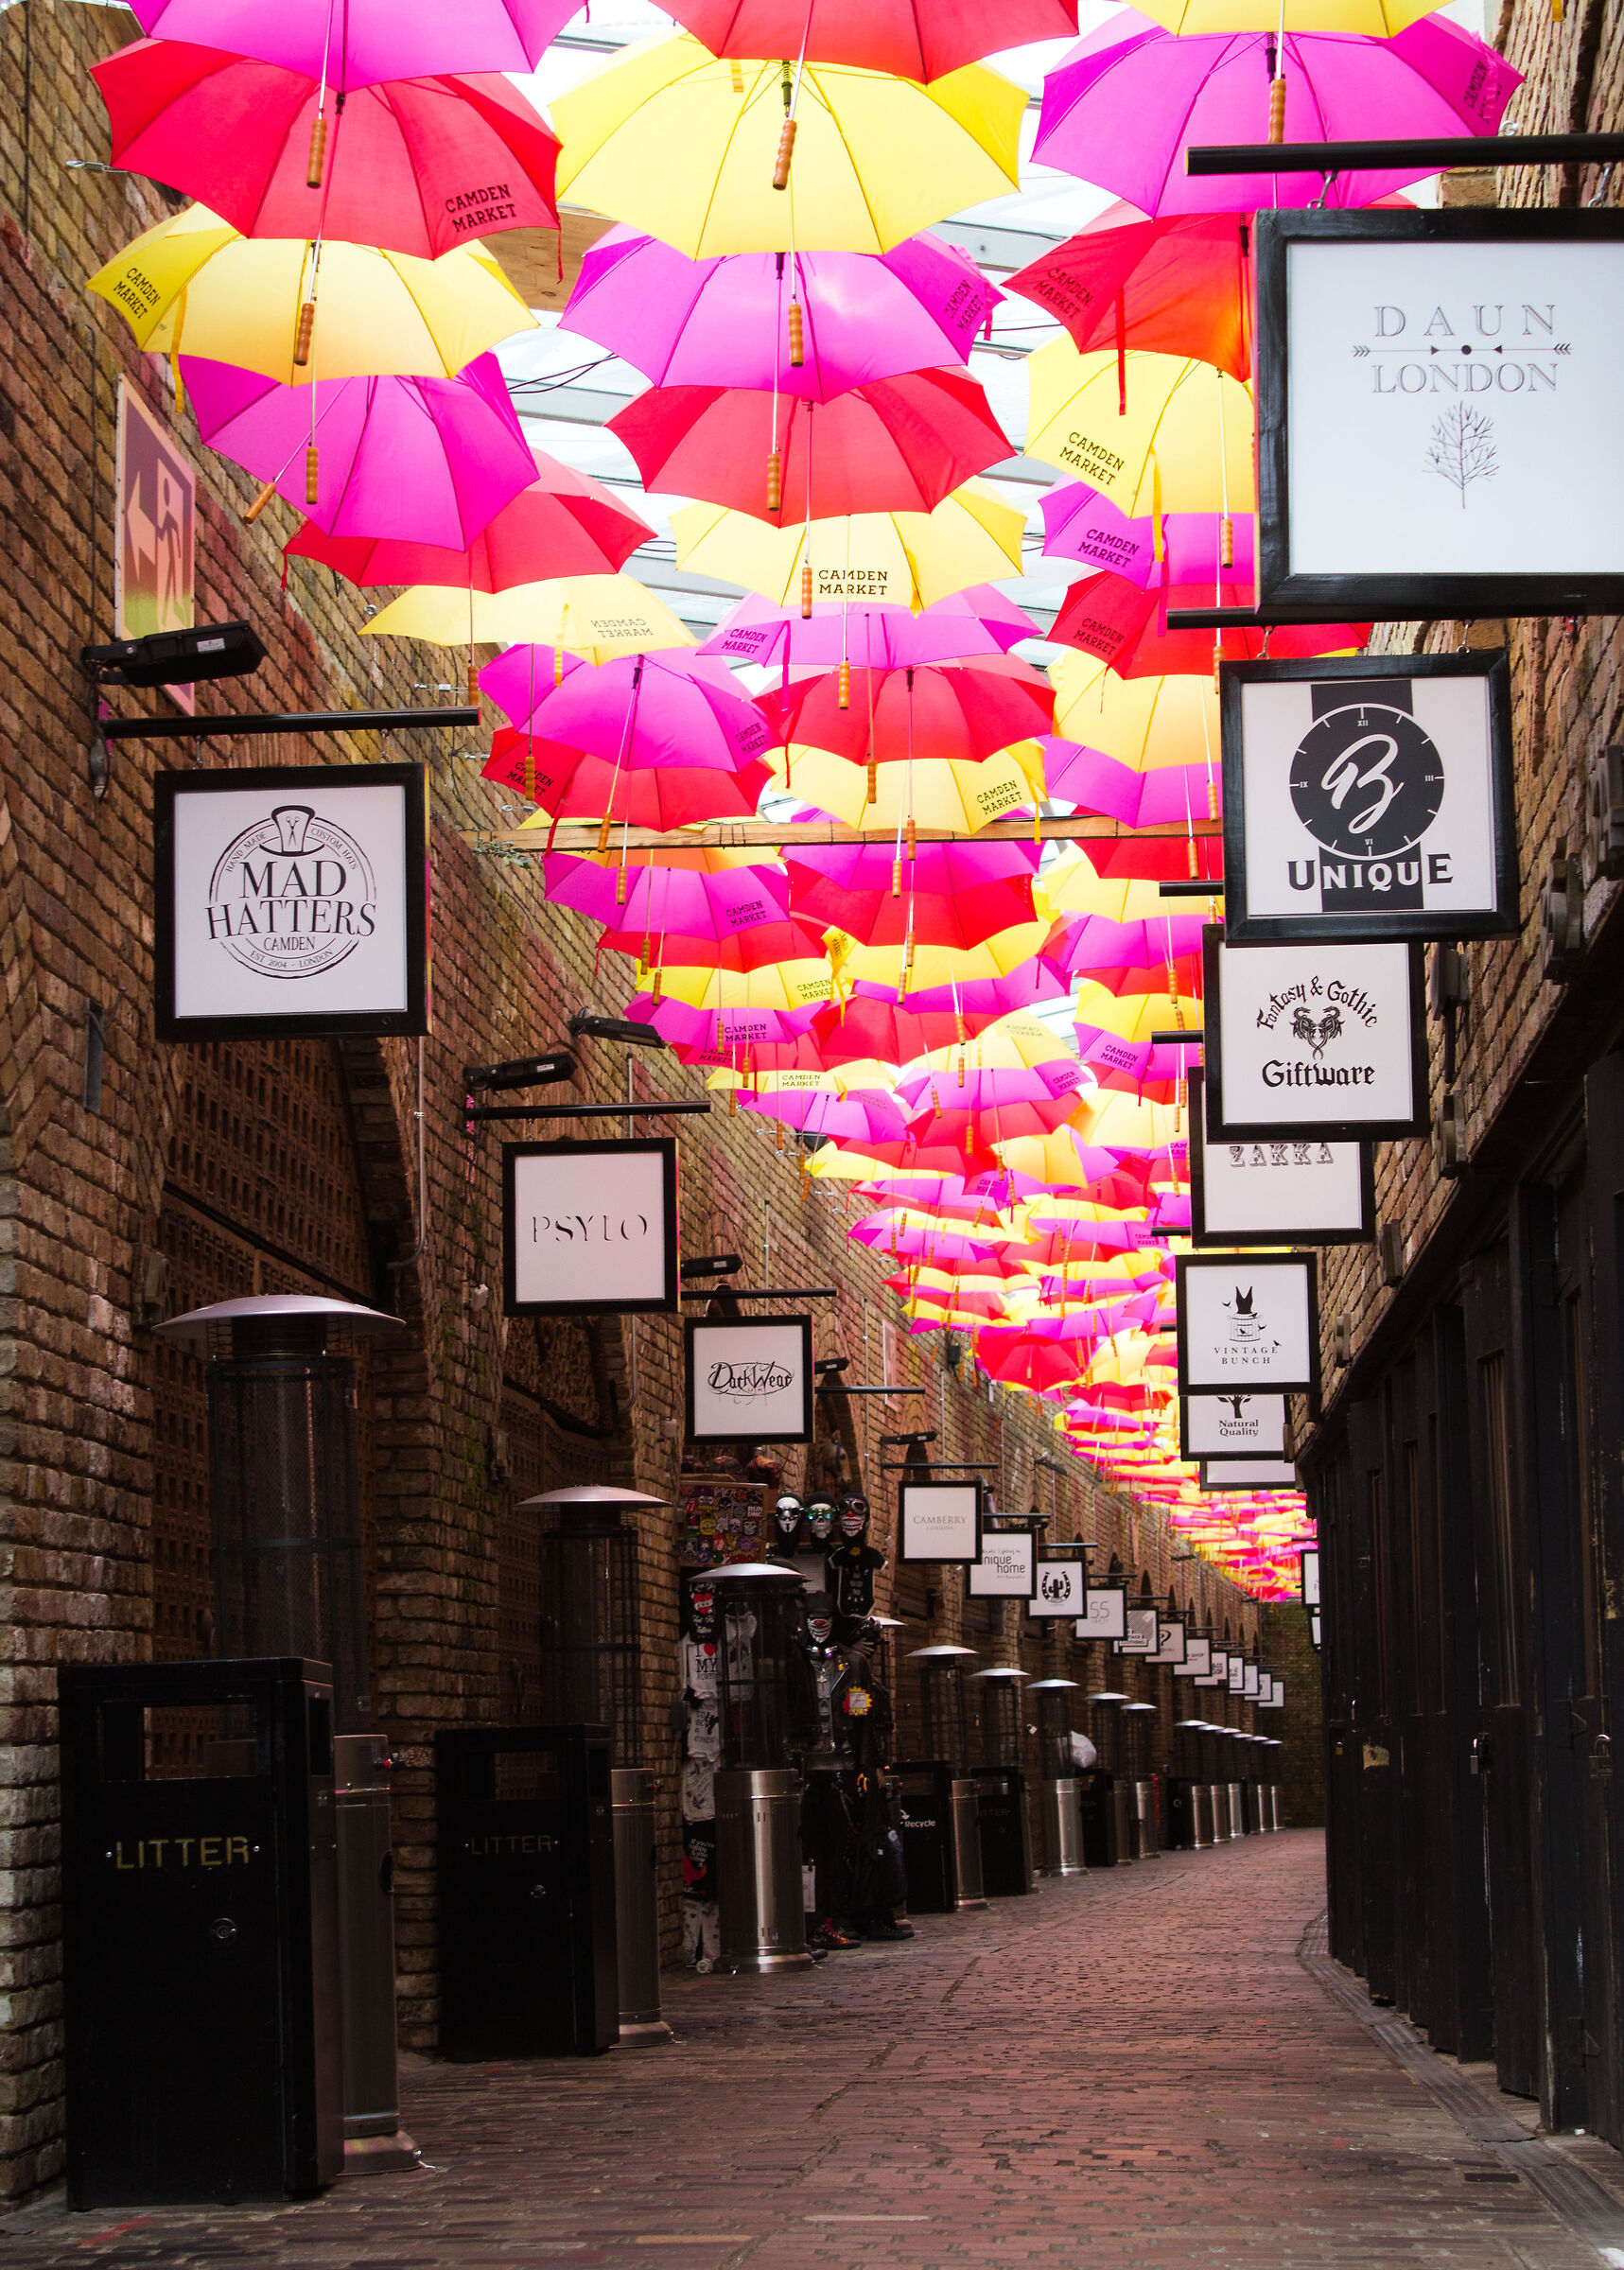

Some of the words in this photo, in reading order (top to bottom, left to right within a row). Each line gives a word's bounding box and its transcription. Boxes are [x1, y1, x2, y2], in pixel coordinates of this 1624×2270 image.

[445, 183, 512, 214] CAMDEN
[451, 203, 517, 233] MARKET
[126, 267, 161, 307] CAMDEN
[1046, 267, 1094, 307] CAMDEN
[113, 281, 148, 320] MARKET
[945, 279, 973, 319] CAMDEN
[1034, 280, 1082, 321] MARKET
[957, 294, 984, 334] MARKET
[1374, 304, 1557, 338] DAUN
[1371, 362, 1559, 394] LONDON
[1068, 431, 1126, 473] CAMDEN
[1058, 445, 1116, 487] MARKET
[1086, 528, 1141, 556] CAMDEN
[1077, 541, 1132, 568] MARKET
[818, 569, 888, 582] CAMDEN
[819, 584, 888, 596] MARKET
[730, 628, 768, 643] CAMDEN
[1074, 630, 1117, 655] MARKET
[1081, 618, 1126, 644] CAMDEN
[722, 640, 760, 655] MARKET
[1357, 719, 1369, 727] XII
[976, 779, 1018, 804] CAMDEN
[982, 791, 1022, 814] MARKET
[226, 849, 244, 873] HAND
[245, 831, 269, 851] MADE
[310, 828, 342, 851] CUSTOM
[341, 849, 359, 870] HATS
[239, 860, 347, 899] MAD
[1286, 853, 1453, 892] UNIQUE
[205, 899, 377, 940] HATTERS
[726, 899, 764, 918] CAMDEN
[730, 911, 768, 928] MARKET
[264, 935, 315, 952] CAMDEN
[250, 951, 265, 964] EST
[268, 958, 287, 969] 2004
[299, 948, 334, 969] LONDON
[797, 979, 831, 993] CAMDEN
[801, 987, 833, 1000] MARKE
[1256, 982, 1306, 1030] Fantasy
[1310, 975, 1323, 996] &
[1327, 980, 1378, 1028] Gothic
[725, 1023, 766, 1035] CAMDEN
[725, 1031, 767, 1043] MARKET
[699, 1055, 733, 1065] MARKET
[1099, 1052, 1134, 1070] MARKET
[1105, 1044, 1139, 1062] CAMDEN
[1262, 1059, 1376, 1088] Giftware
[1230, 1143, 1335, 1168] ZAKKA
[1214, 1346, 1279, 1354] VINTAGE
[1221, 1356, 1271, 1365] BUNCH
[1219, 1419, 1259, 1428] Natural
[1219, 1427, 1259, 1438] Quality
[913, 1515, 967, 1524] CAMBERRY
[984, 1556, 1012, 1565] nique
[997, 1564, 1025, 1574] home
[1090, 1600, 1110, 1619] 55
[696, 1658, 718, 1673] MY
[905, 1818, 935, 1828] Recycle
[116, 1836, 249, 1870] LITTER
[470, 1833, 552, 1856] LITTER
